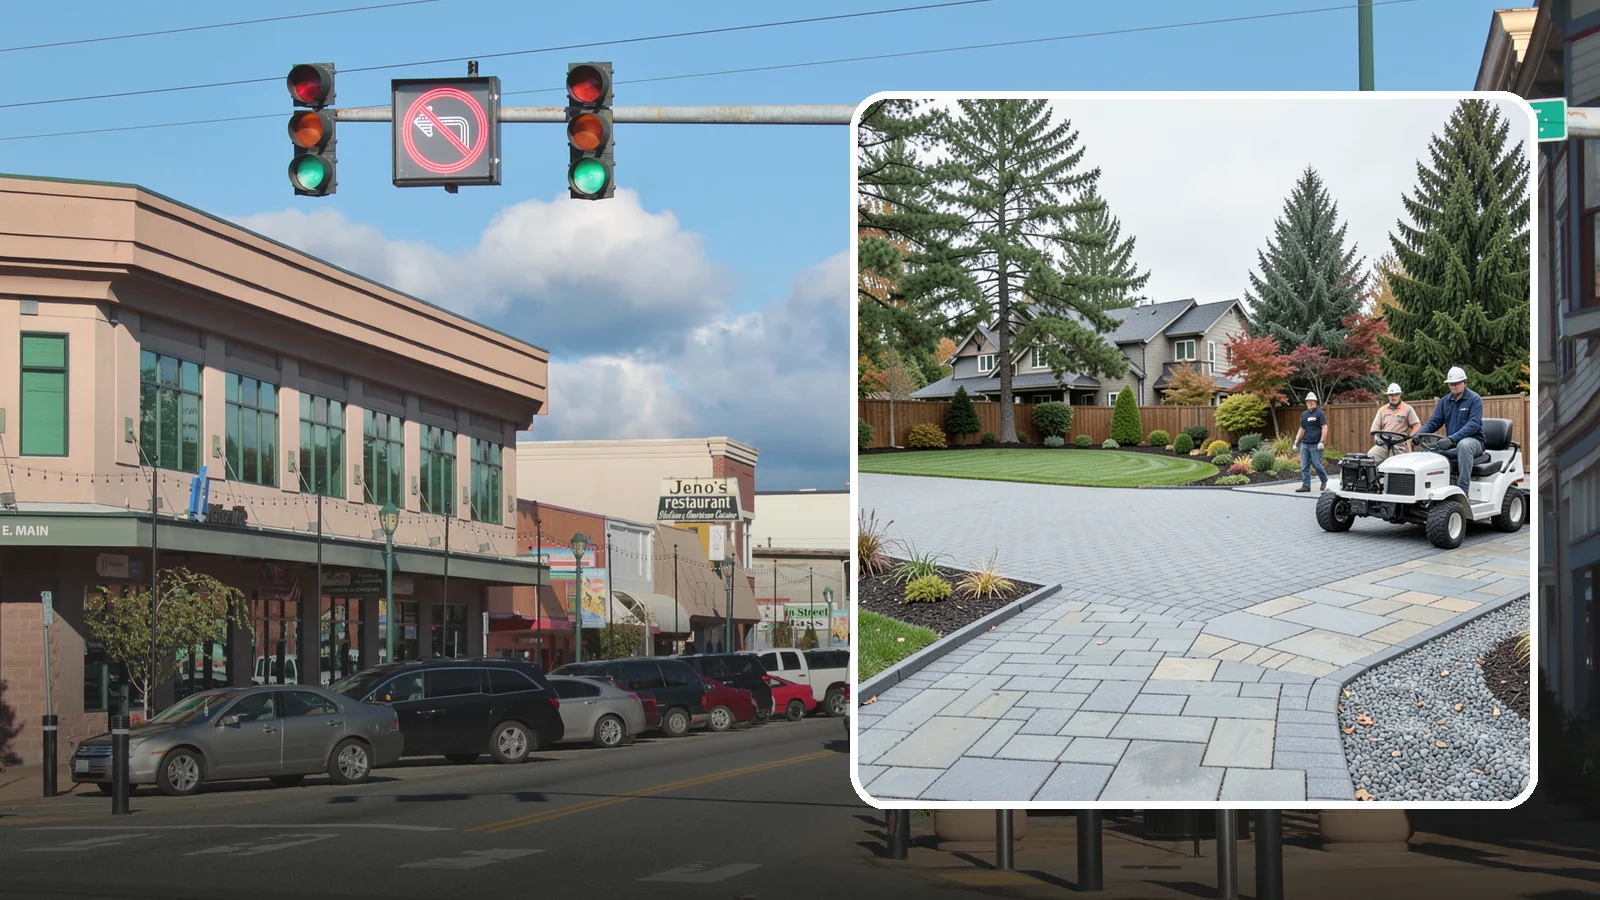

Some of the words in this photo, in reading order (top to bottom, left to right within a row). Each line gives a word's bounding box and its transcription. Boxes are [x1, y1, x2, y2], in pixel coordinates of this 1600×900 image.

[670, 480, 727, 494] Jeno's
[665, 496, 731, 509] restaurant
[686, 510, 715, 520] American
[715, 509, 738, 520] Cuisine
[2, 525, 13, 536] E.
[15, 525, 49, 536] MAIN
[797, 607, 828, 617] Street
